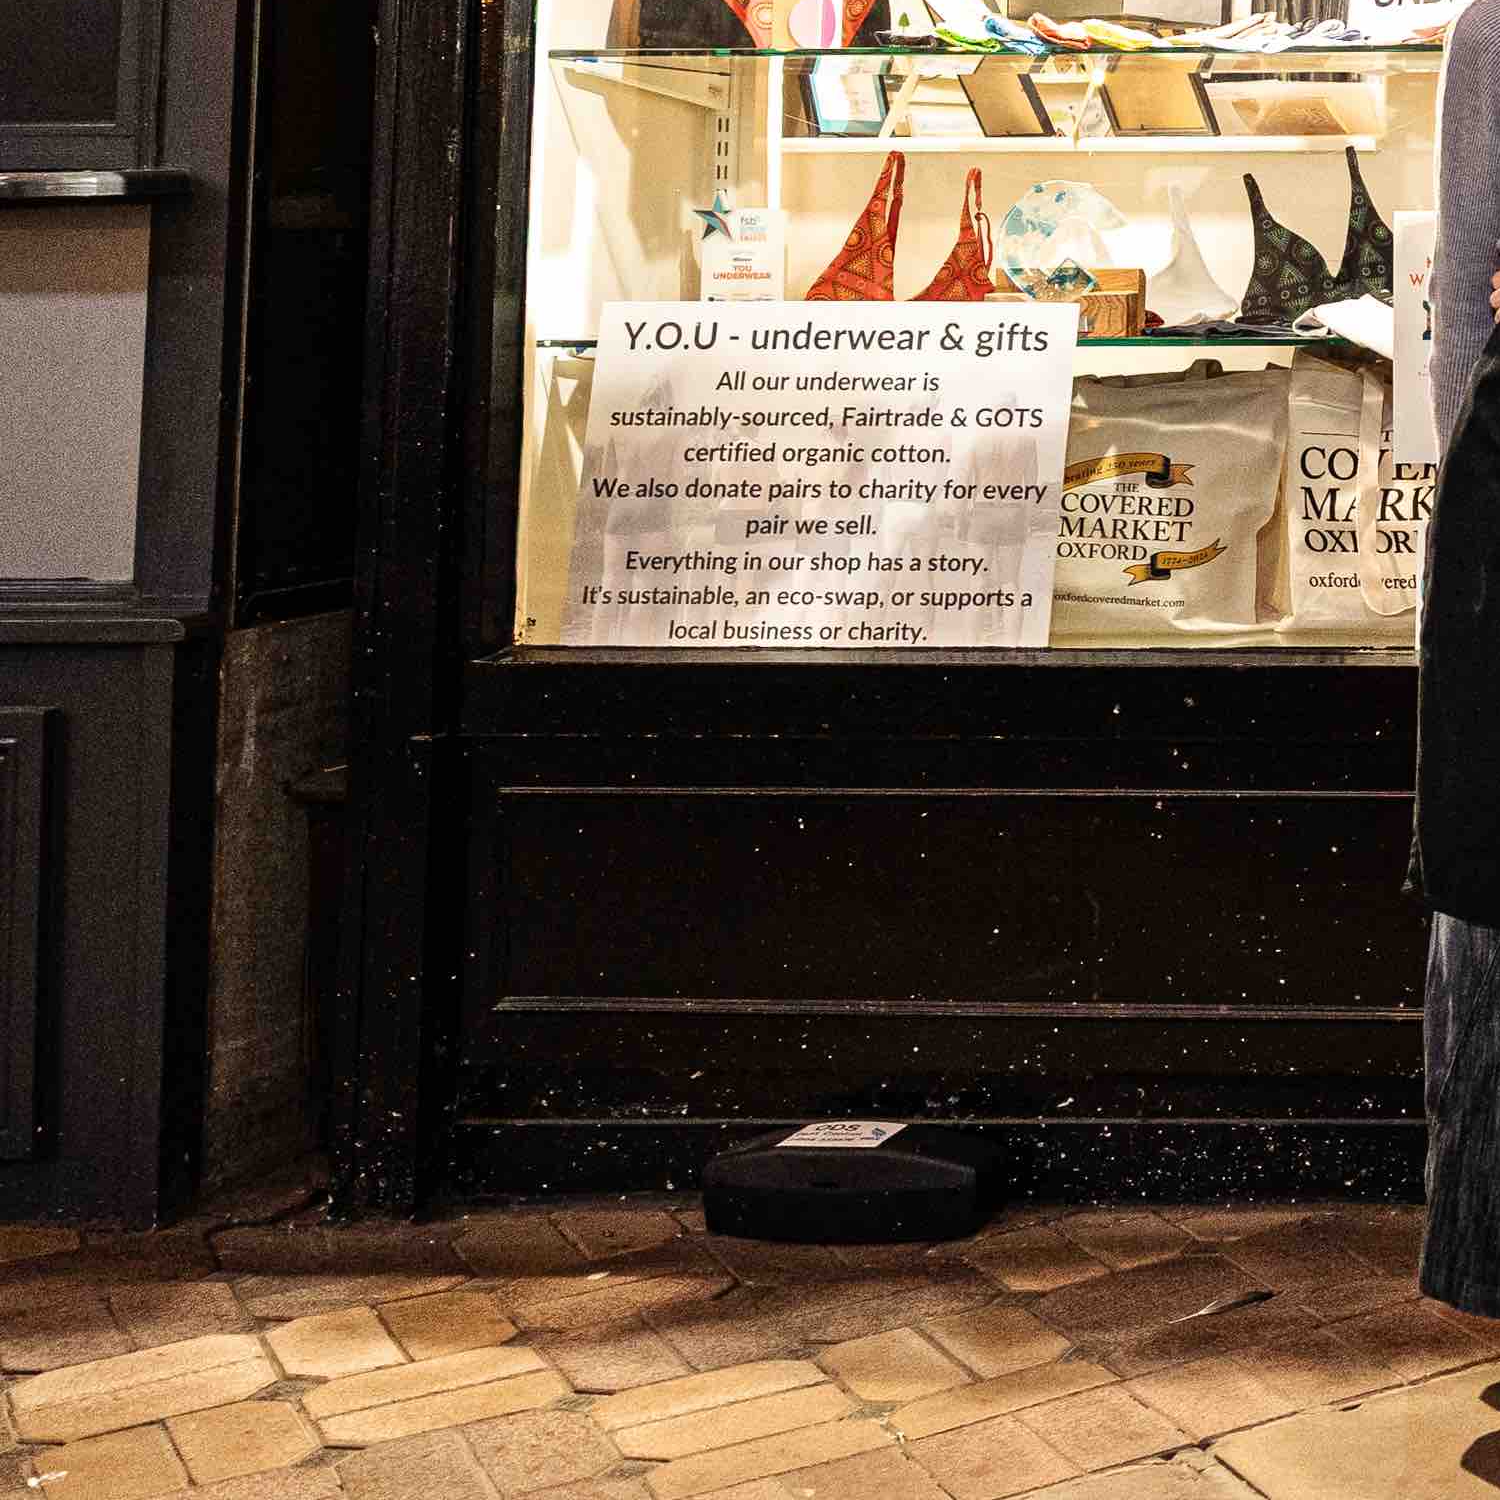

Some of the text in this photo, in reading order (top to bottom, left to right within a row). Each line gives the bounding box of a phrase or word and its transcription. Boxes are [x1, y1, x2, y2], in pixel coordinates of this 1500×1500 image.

[712, 272, 773, 280] UNDERWEAR
[623, 321, 718, 350] Y.O.U
[751, 322, 930, 351] underwear
[940, 322, 964, 351] &
[975, 322, 1049, 357] gifts
[716, 371, 940, 392] All our underwear is
[610, 407, 1043, 431] sustainably-sourced, Fairtrade & GOTS
[683, 442, 951, 470] certified organic cotton.
[592, 478, 1048, 507] We also donate pairs to charity for every
[1114, 483, 1139, 492] THE
[1061, 493, 1194, 517] COVERED
[746, 515, 877, 540] pair we sell.
[1058, 516, 1193, 542] MARKET
[625, 551, 989, 577] Everything in our shop has a story.
[1057, 542, 1147, 561] OXFORD
[582, 585, 1033, 613] It's sustainable, an eco-swap, or supports a
[1054, 592, 1185, 607] oxfordcoveredmarket.com
[668, 620, 928, 647] local business or charity.
